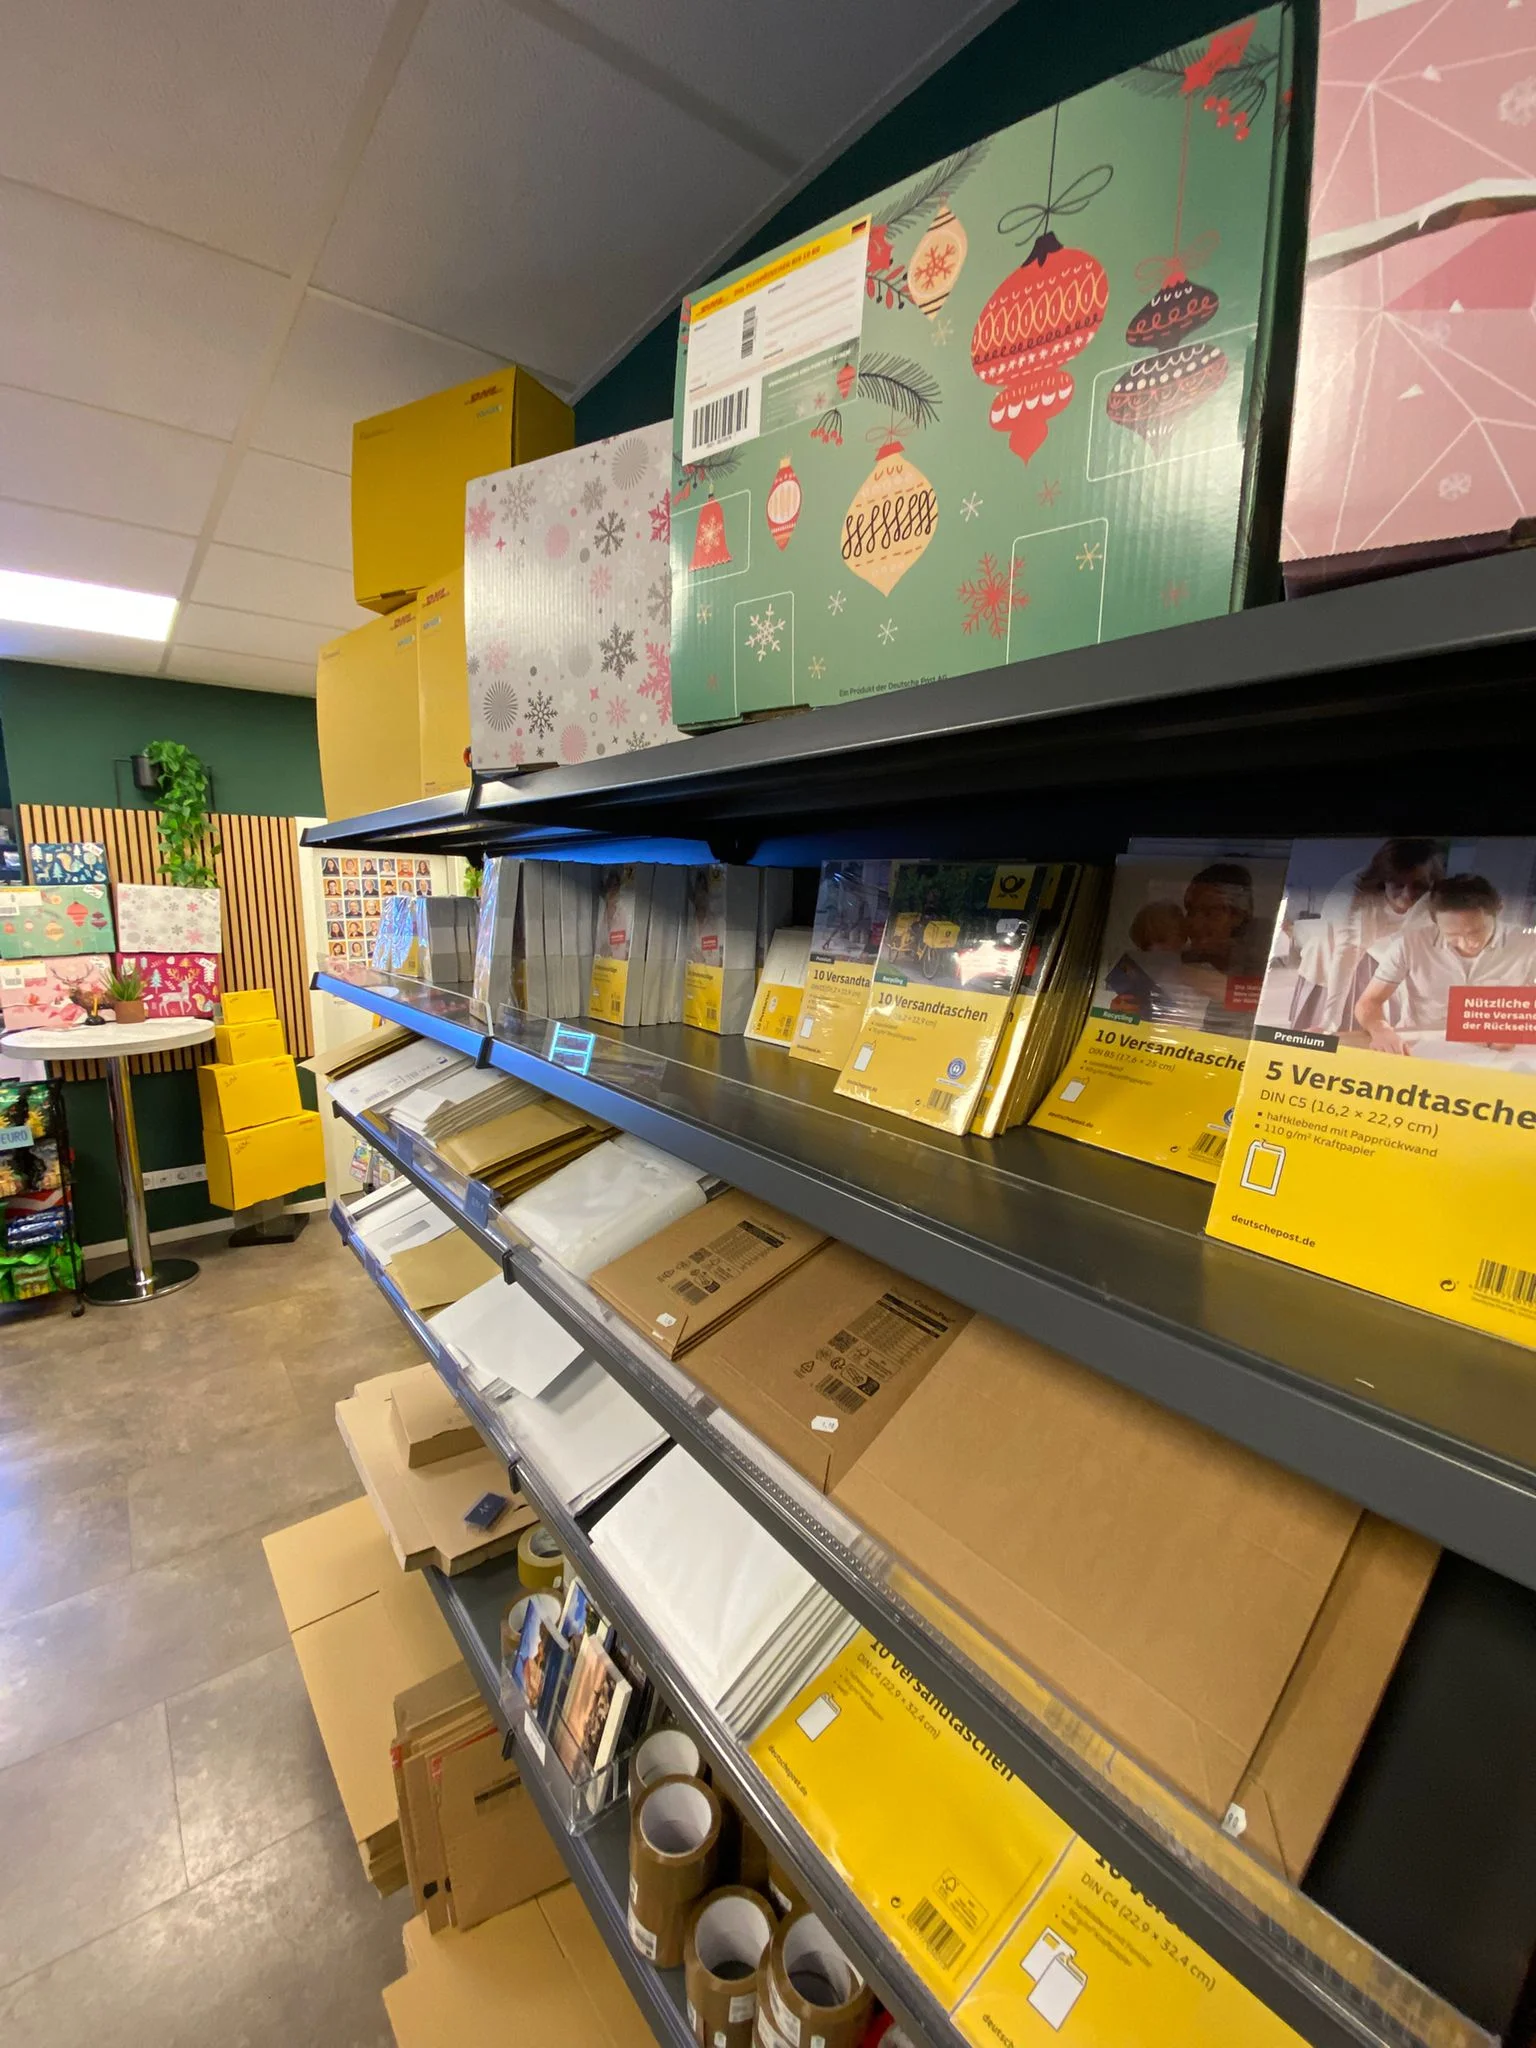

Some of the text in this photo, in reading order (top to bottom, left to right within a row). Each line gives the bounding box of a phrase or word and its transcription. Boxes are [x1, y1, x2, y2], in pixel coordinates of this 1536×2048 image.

[875, 682, 887, 692] der
[813, 969, 825, 981] 10
[878, 992, 893, 1005] 10
[895, 994, 989, 1023] Versandtaschen
[1102, 1011, 1134, 1023] Recycling
[1463, 1011, 1491, 1020] Bitte
[1464, 998, 1531, 1009] Nützliche
[1274, 1031, 1325, 1047] Premium
[1462, 1022, 1481, 1030] der
[1096, 1029, 1116, 1045] 10
[1119, 1034, 1245, 1072] Versandtasche
[1145, 1060, 1157, 1068] 25
[1158, 1063, 1176, 1073] cm)
[1265, 1060, 1536, 1130] 5 Versandtasche
[1260, 1089, 1286, 1104] DIN
[1288, 1094, 1307, 1109] C5
[1311, 1099, 1350, 1118] (16,2
[1367, 1111, 1404, 1129] 22,9
[1407, 1121, 1439, 1139] cm)
[1265, 1123, 1376, 1157] 110 g/m² Kraftpapier
[1267, 1111, 1438, 1158] haftklebend mit Papprückwand
[1231, 1214, 1316, 1248] deutschepost.de
[879, 1676, 901, 1698] (22,9
[906, 1702, 925, 1723] 32,4
[923, 1720, 941, 1740] cm)
[768, 1744, 808, 1797] deutschepost.de
[1081, 1872, 1104, 1896] DIN
[1102, 1890, 1120, 1909] C4
[1118, 1905, 1150, 1934] (22,9
[1160, 1936, 1190, 1968] 32,4
[1190, 1964, 1217, 1993] cm)
